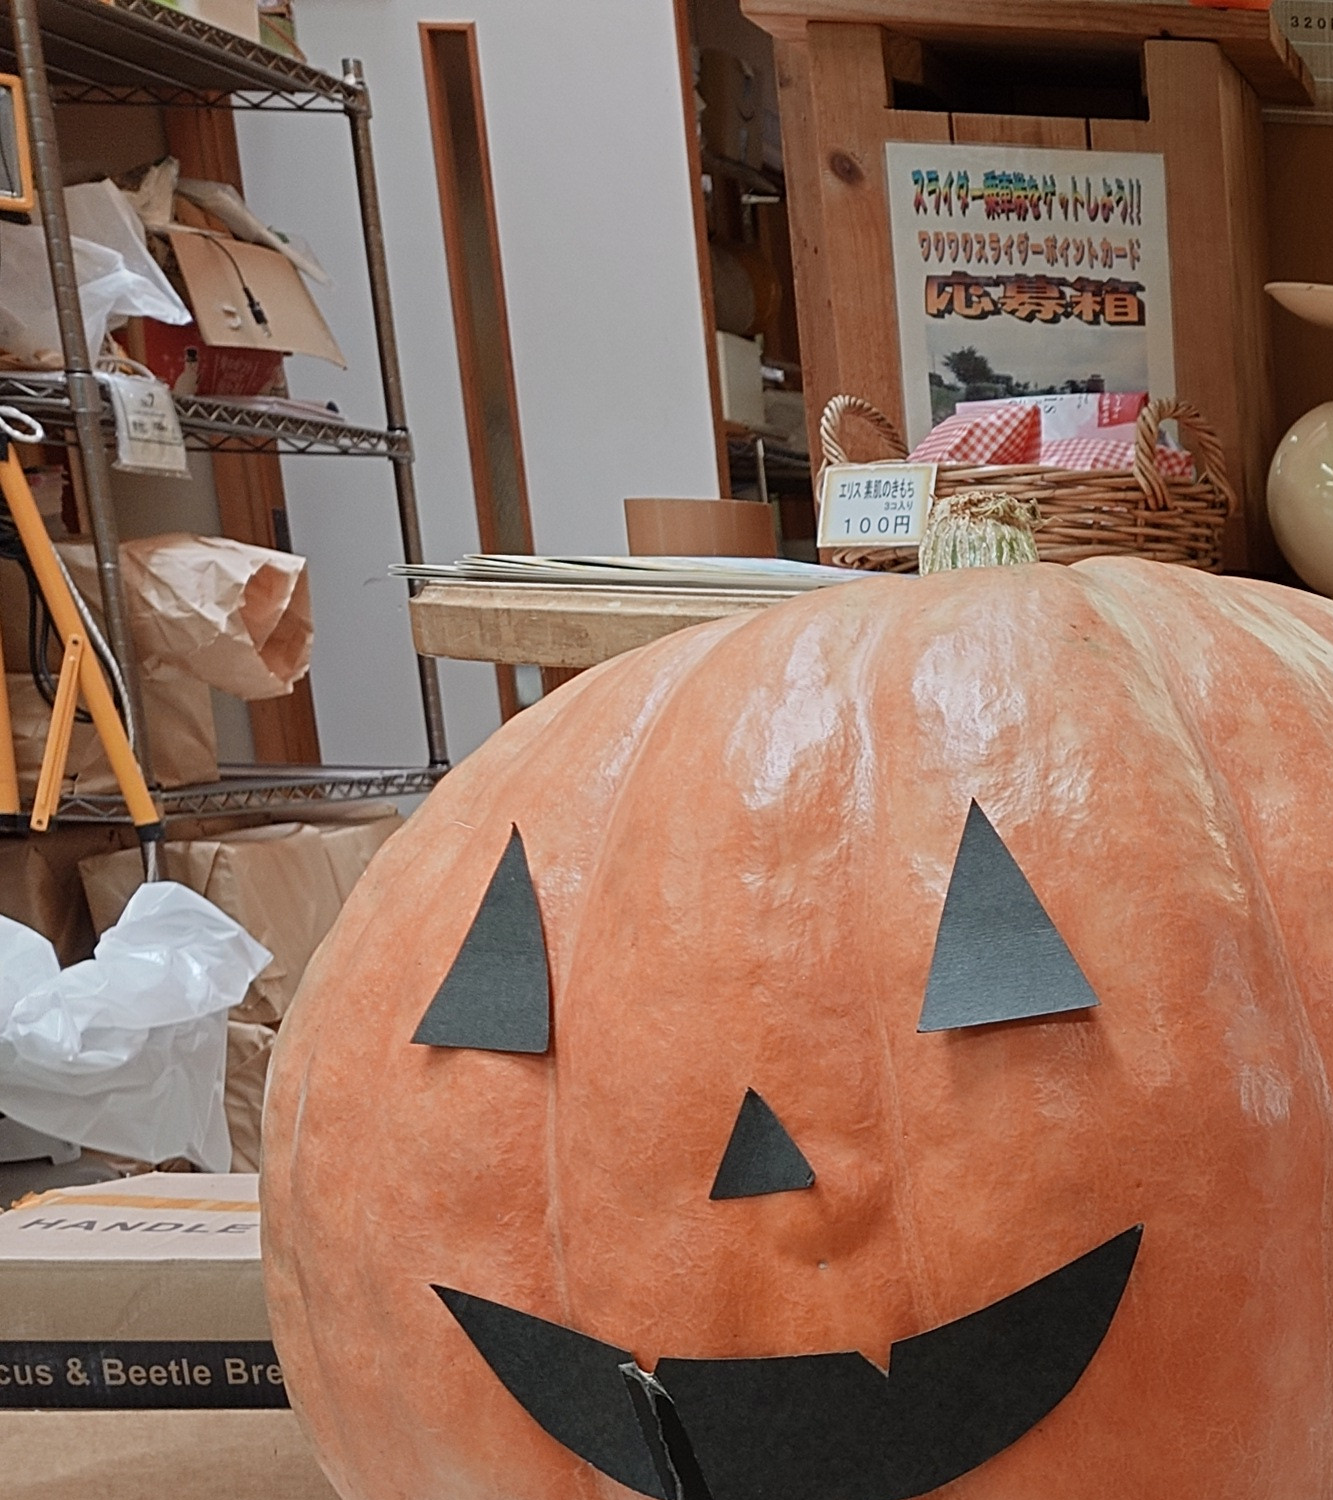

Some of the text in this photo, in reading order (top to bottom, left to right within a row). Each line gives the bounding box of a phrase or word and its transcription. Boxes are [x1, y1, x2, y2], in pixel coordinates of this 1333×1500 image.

[924, 270, 1146, 326] 応募箱
[844, 515, 911, 534] 100円
[18, 1218, 259, 1234] HANDLE
[66, 1357, 91, 1386] &
[102, 1358, 213, 1386] Beetle
